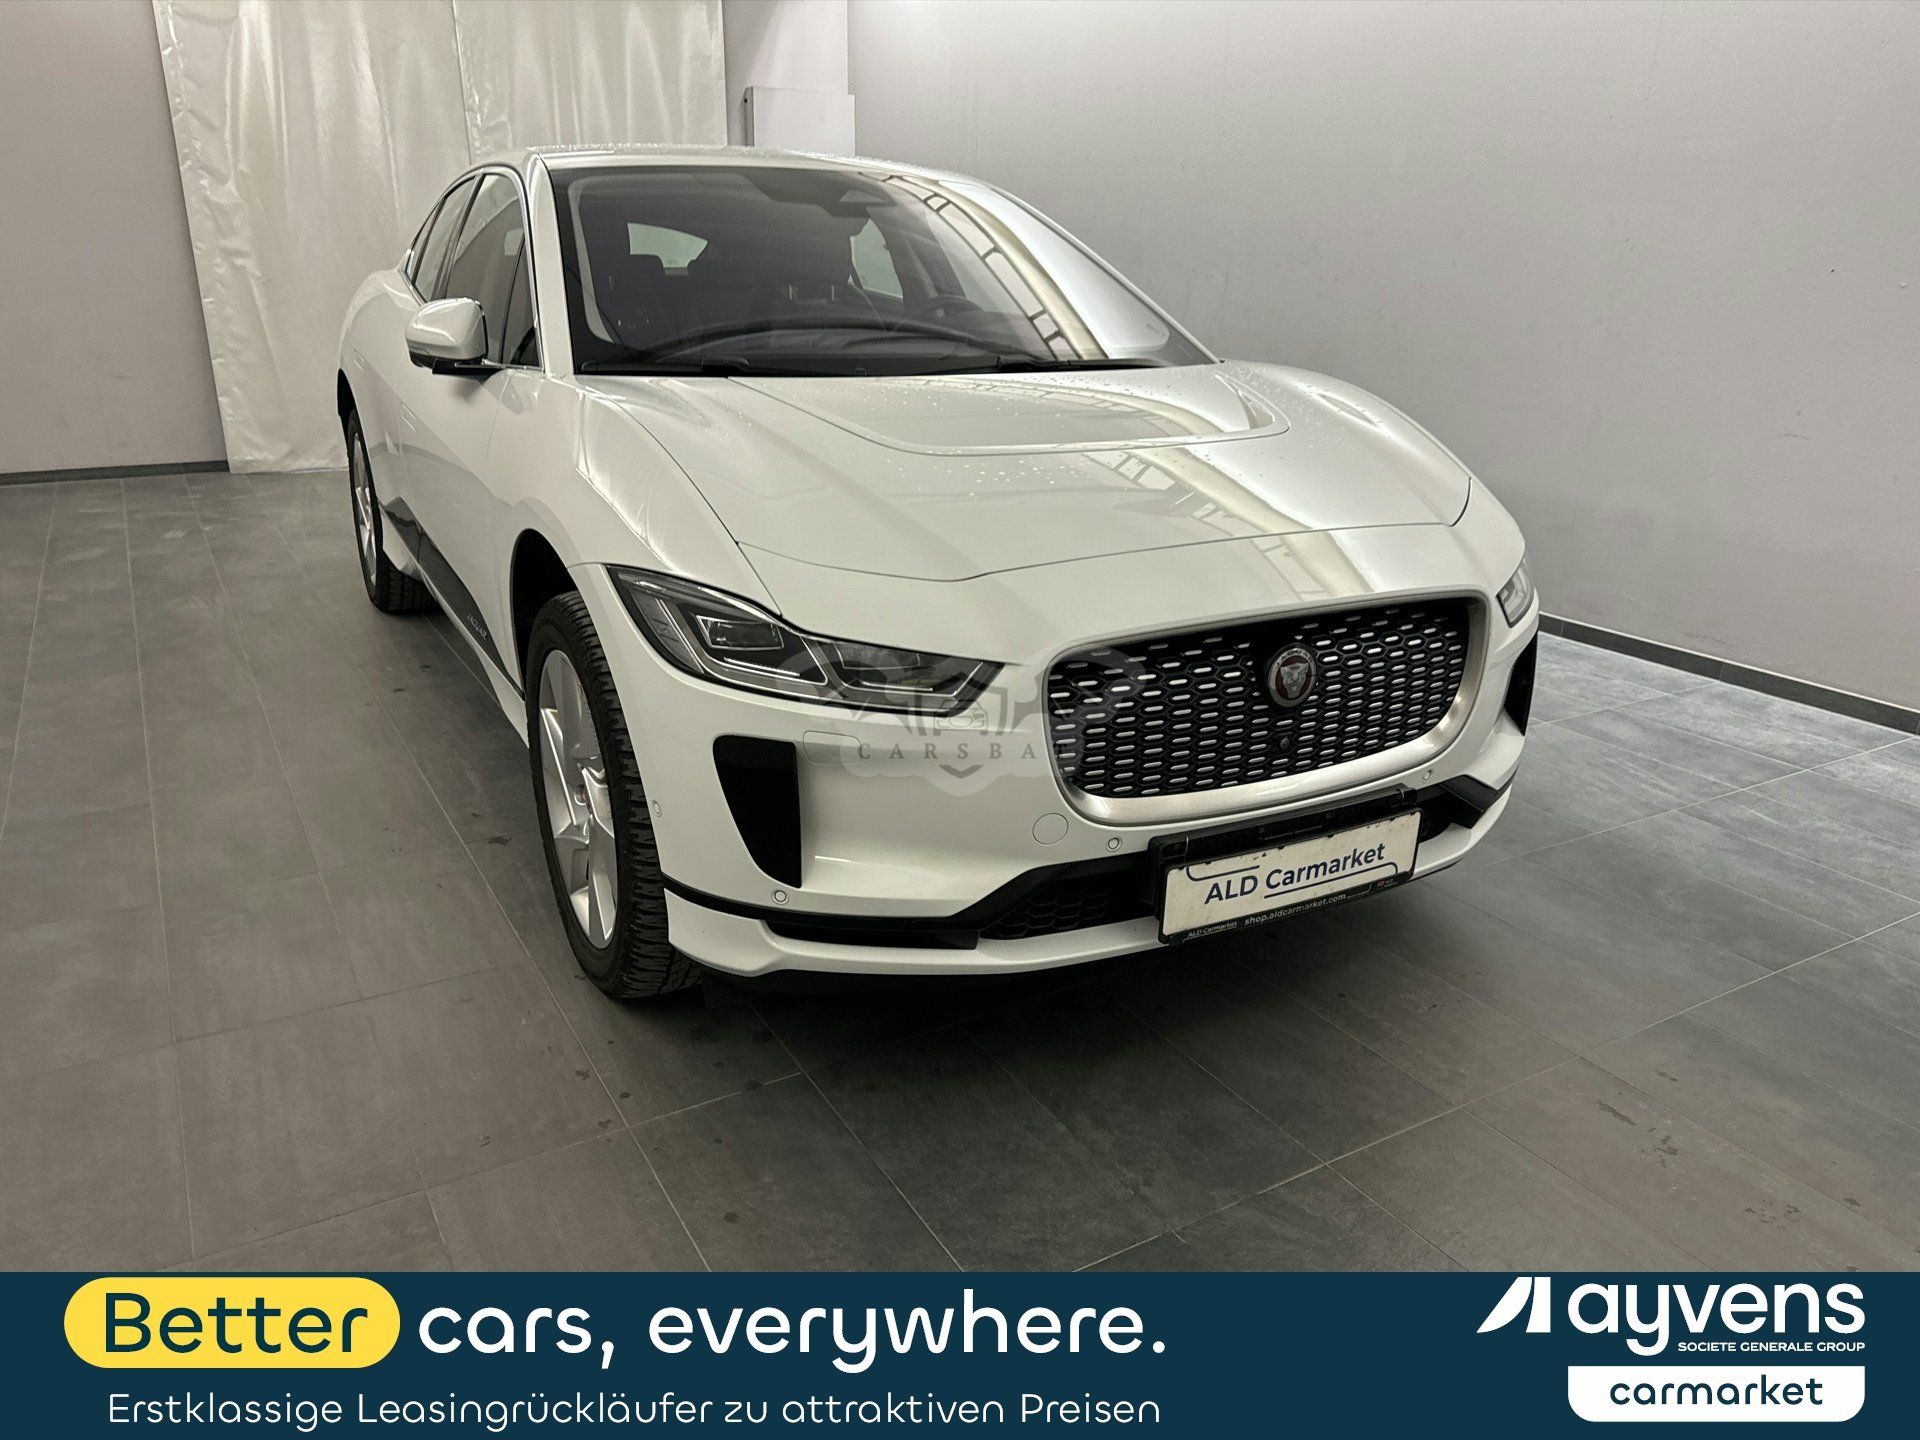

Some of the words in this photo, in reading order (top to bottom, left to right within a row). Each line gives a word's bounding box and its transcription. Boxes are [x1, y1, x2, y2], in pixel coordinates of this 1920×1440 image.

[1204, 875, 1258, 905] ALD
[1265, 842, 1386, 891] Carmarket
[1244, 893, 1346, 926] shop.aldcarmarket.com
